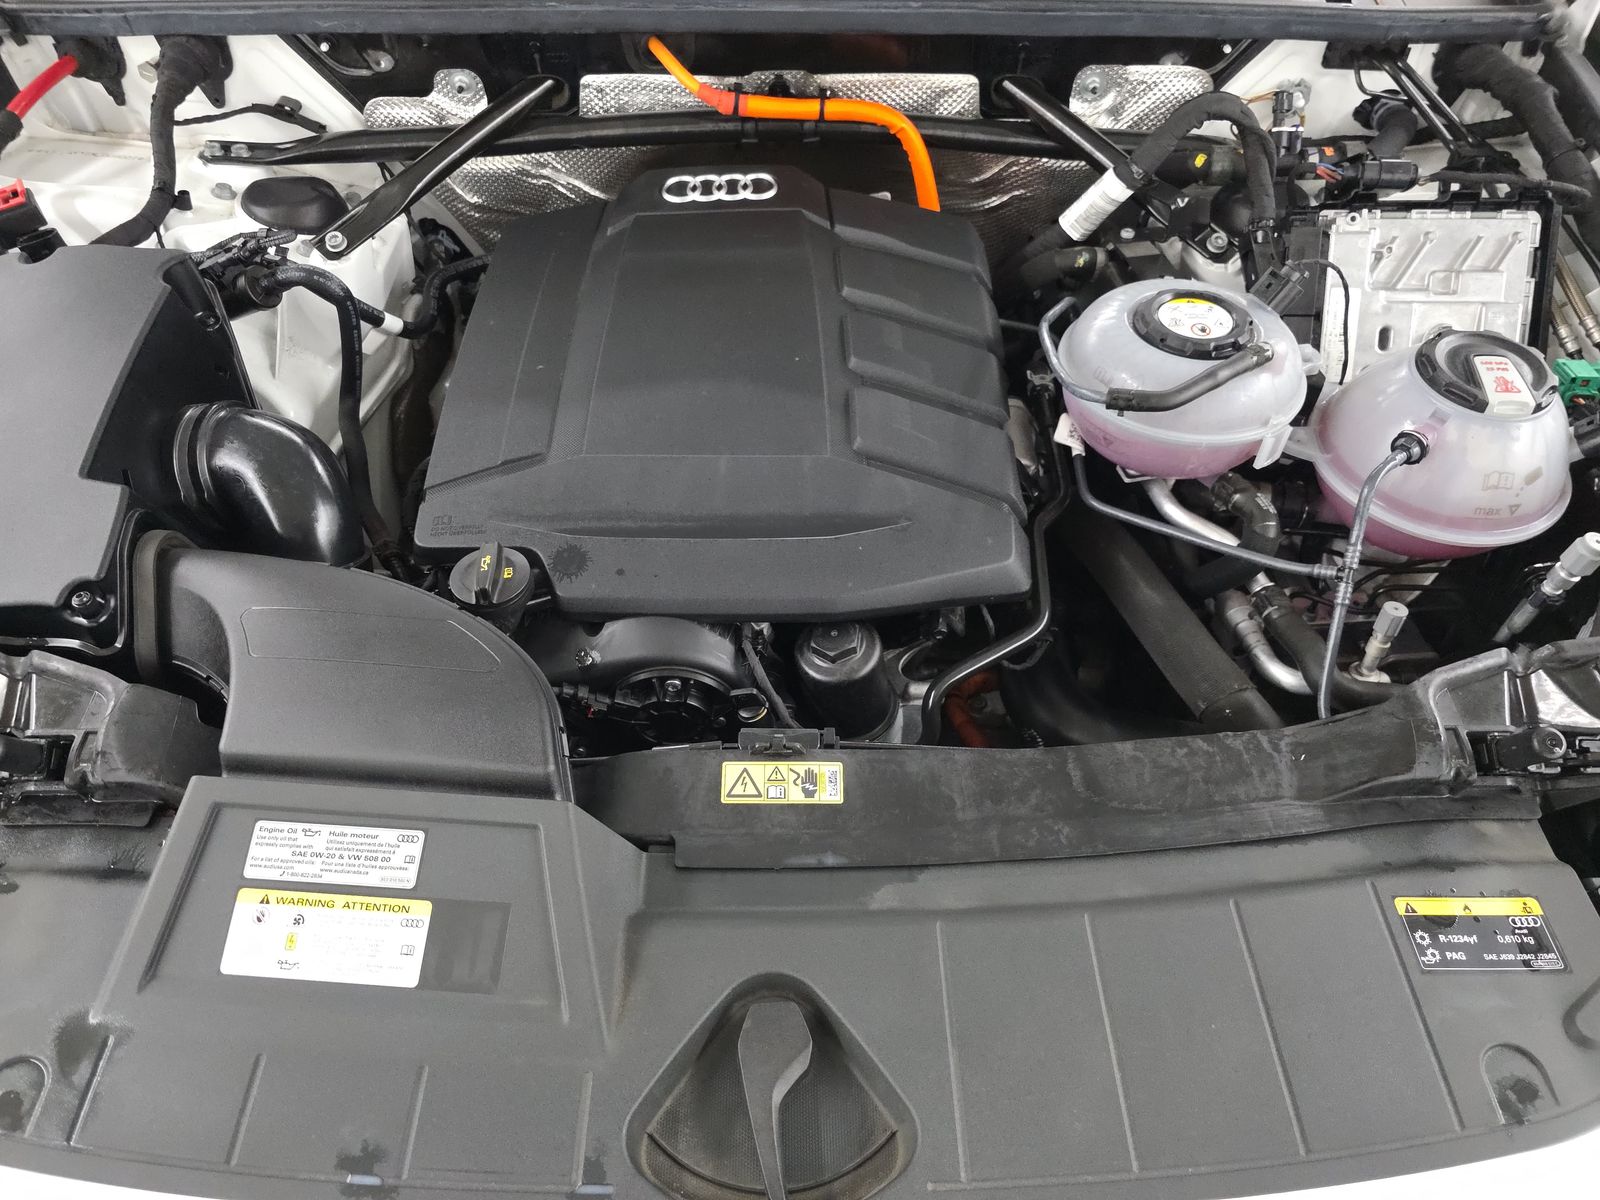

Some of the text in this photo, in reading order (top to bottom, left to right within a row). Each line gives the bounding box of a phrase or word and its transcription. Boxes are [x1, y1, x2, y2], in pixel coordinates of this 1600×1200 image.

[1473, 506, 1502, 516] max
[259, 826, 285, 834] Engine
[329, 830, 379, 840] Huile moteur
[334, 845, 355, 853] satisfait
[345, 840, 376, 848] uniquement
[291, 850, 308, 858] SAE
[309, 851, 336, 860] 0W-20
[275, 896, 410, 914] WARNING ATTENTION
[1438, 934, 1535, 945] R-1234yf 0,610 kg
[1445, 951, 1467, 961] PAG
[1483, 953, 1499, 961] SAE
[1516, 952, 1536, 961] J2842
[1537, 952, 1558, 960] J2845
